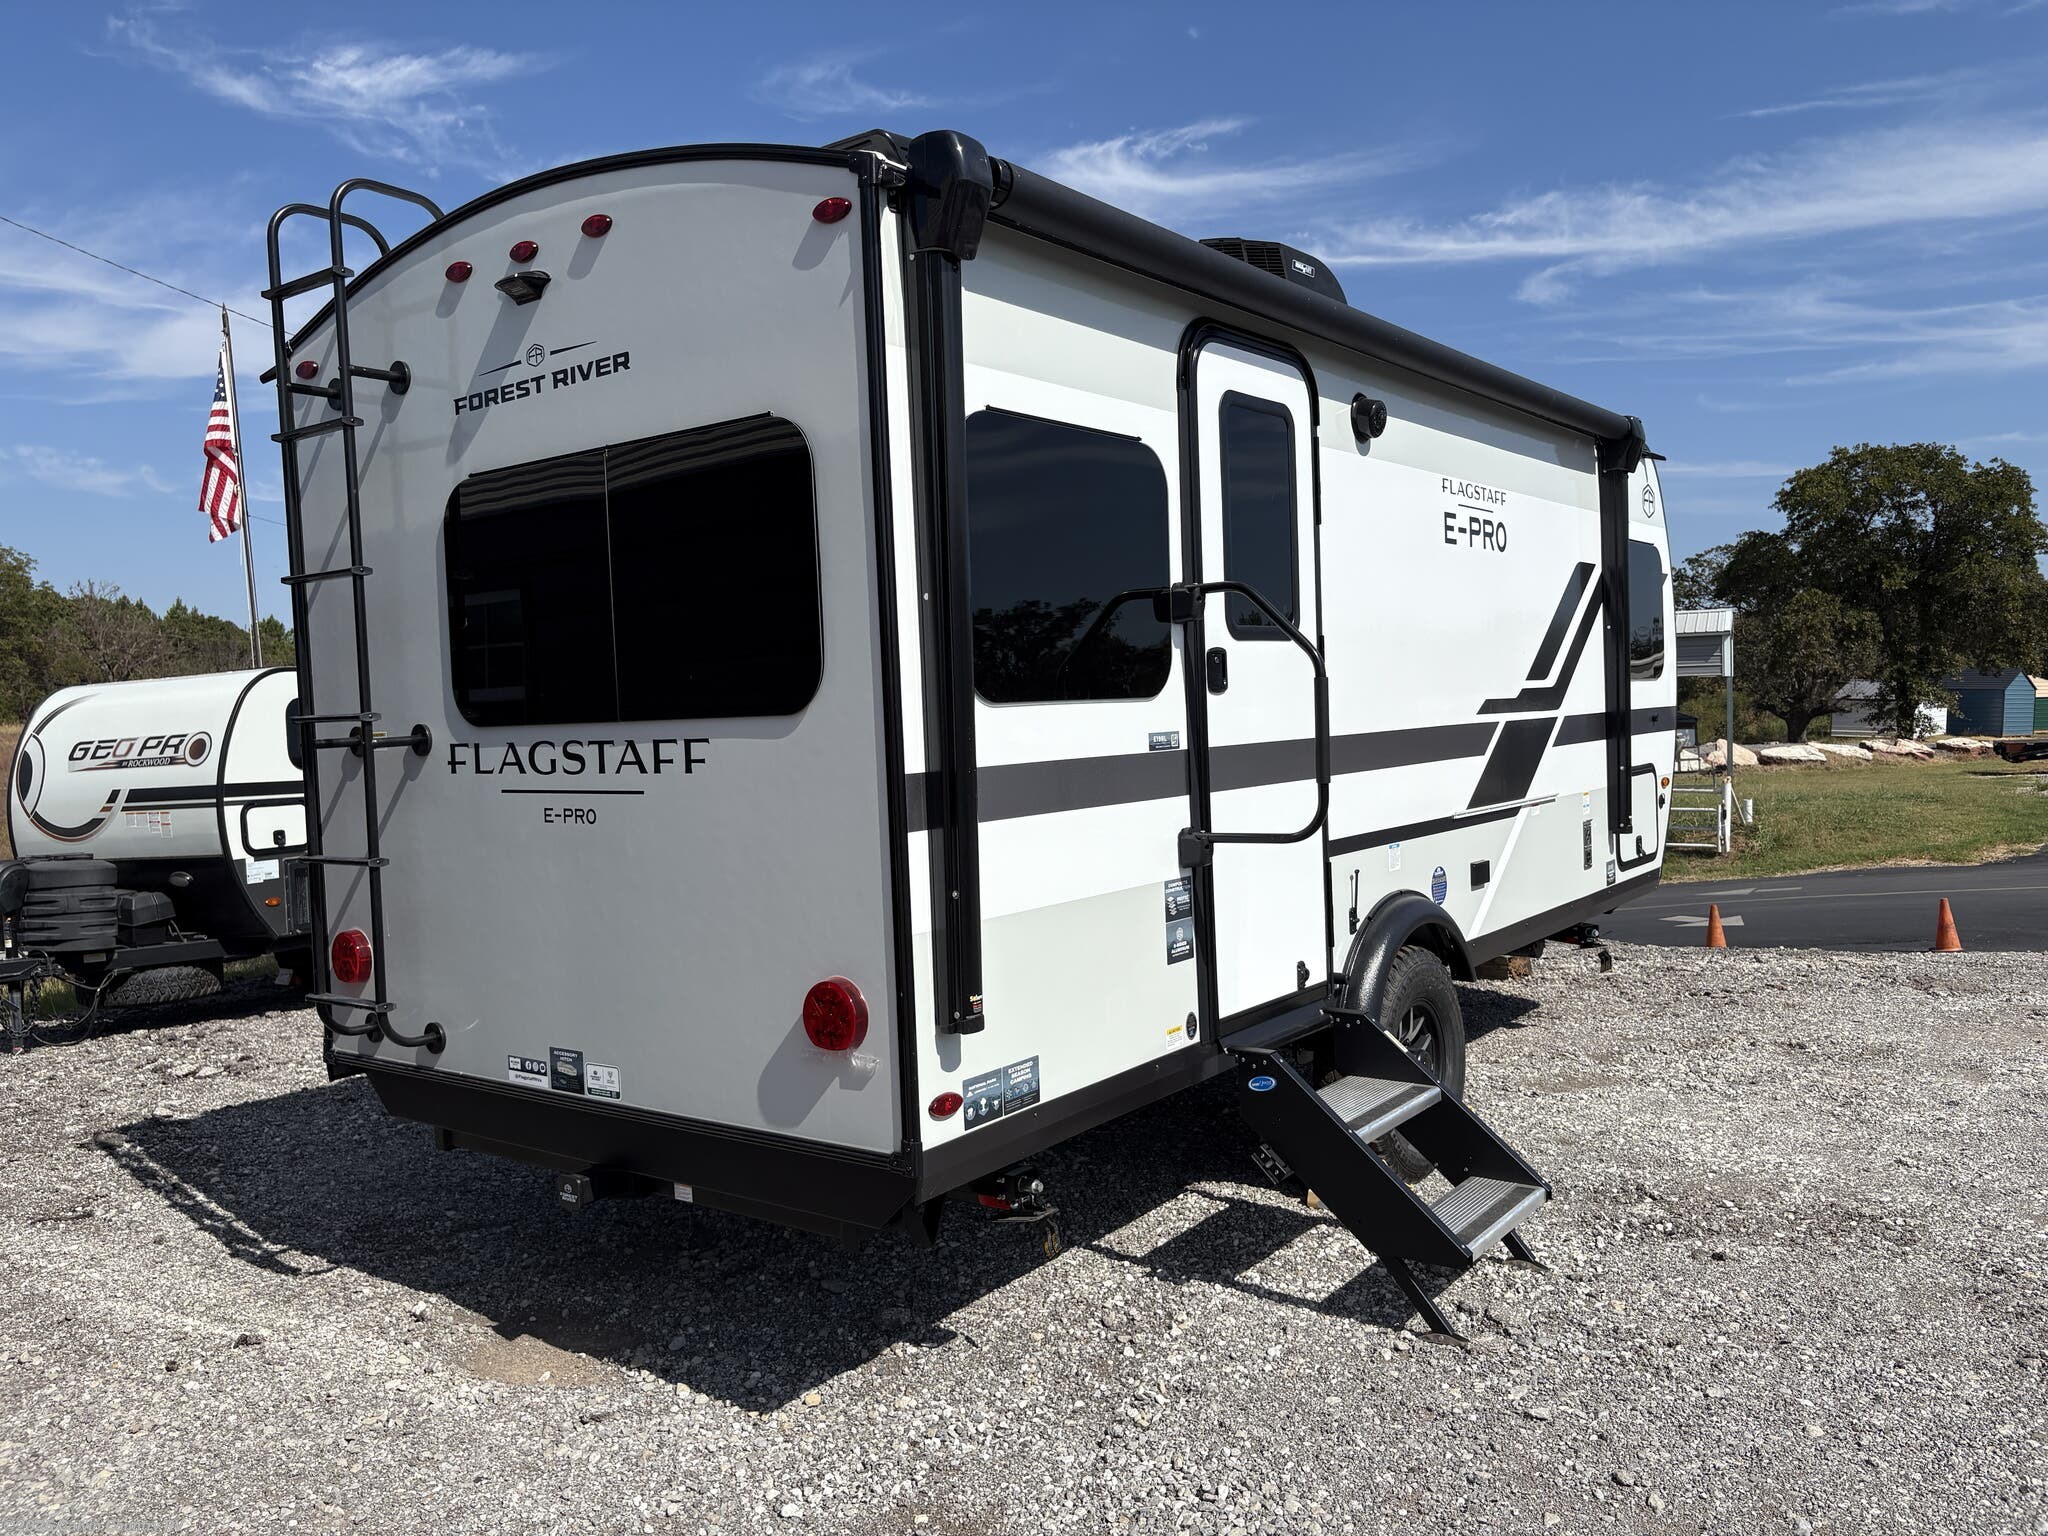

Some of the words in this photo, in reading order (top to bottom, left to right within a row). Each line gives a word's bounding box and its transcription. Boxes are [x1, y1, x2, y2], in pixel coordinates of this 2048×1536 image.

[453, 374, 546, 416] FOREST
[551, 351, 631, 390] RIVER
[1441, 478, 1507, 506] FLAGSTAFF
[1444, 511, 1507, 552] E-PRO
[68, 738, 138, 761] GEO
[137, 731, 212, 767] PRO
[447, 738, 710, 775] FLAGSTAFF
[127, 757, 171, 768] ROCKWOOD
[543, 807, 597, 825] E-PRO
[1008, 1061, 1033, 1074] EXTENDED
[1010, 1073, 1032, 1085] CAMPING
[1011, 1067, 1031, 1079] SEASON
